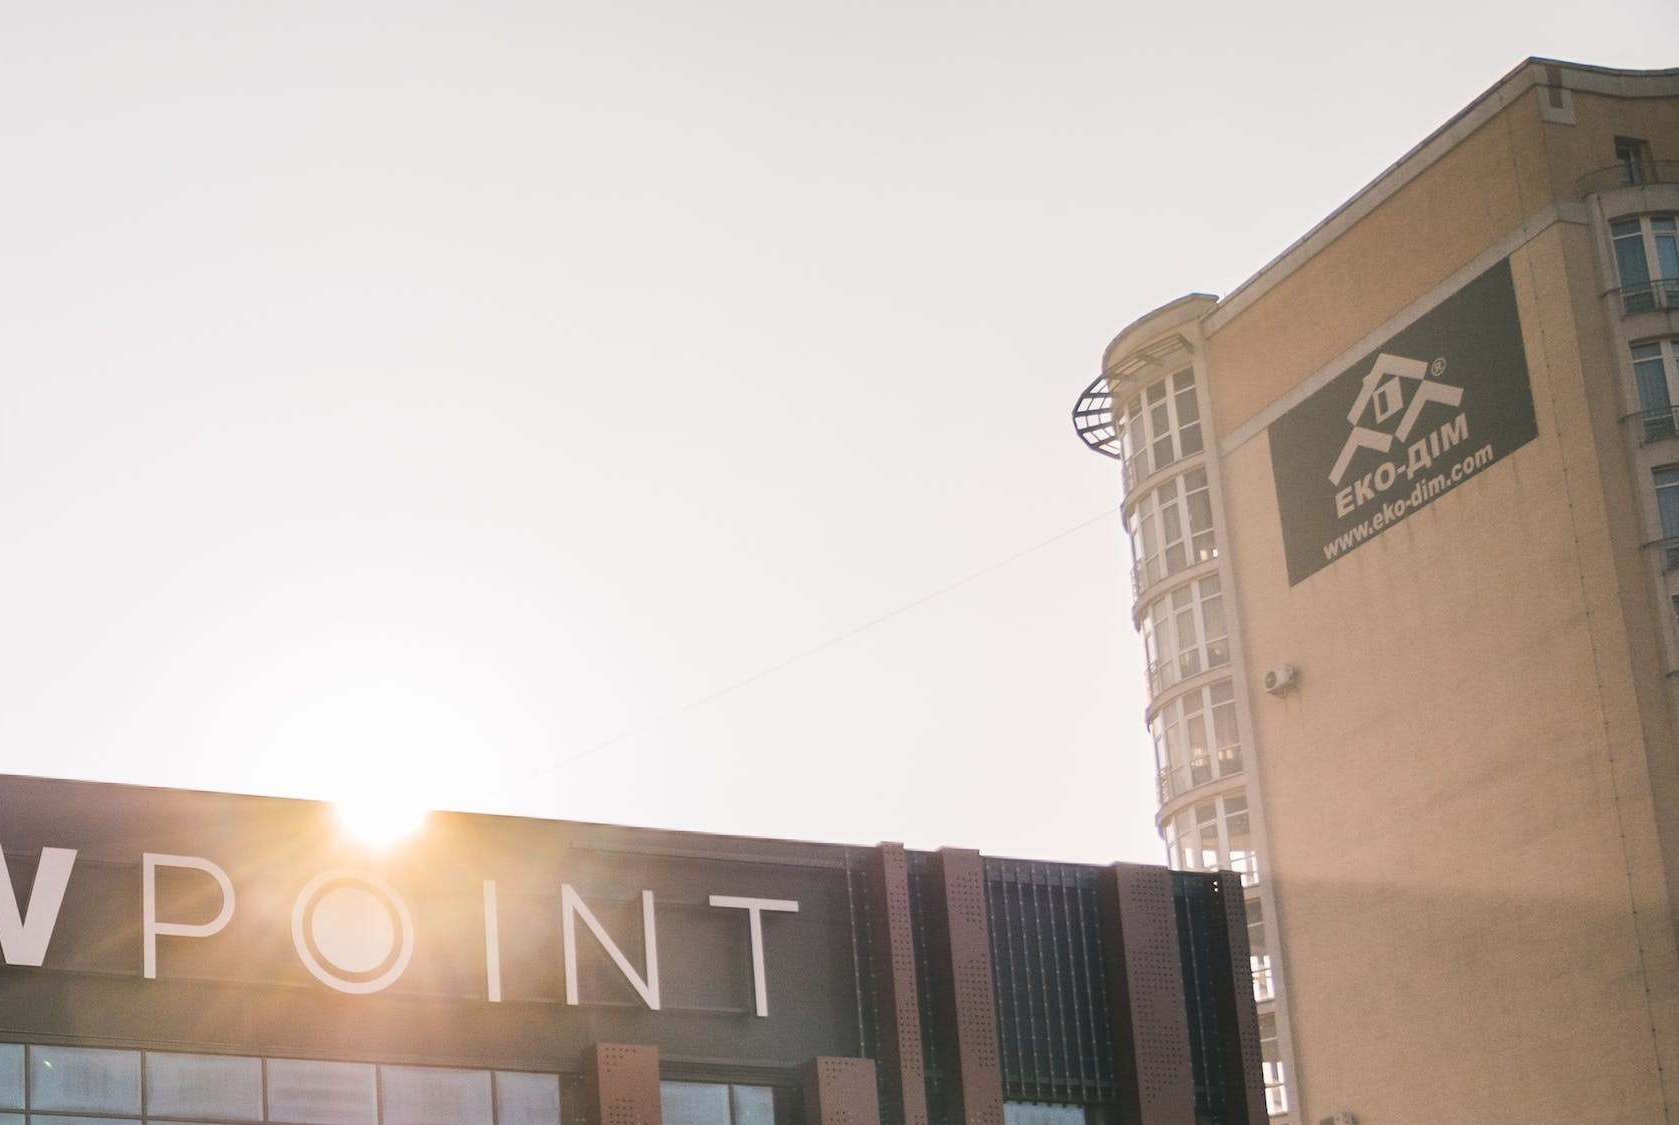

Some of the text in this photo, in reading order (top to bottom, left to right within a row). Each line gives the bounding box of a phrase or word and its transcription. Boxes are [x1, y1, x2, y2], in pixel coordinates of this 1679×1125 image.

[1322, 443, 1495, 561] www.eko-dim.com
[1334, 412, 1469, 519] ЕКО-ДІМ
[142, 852, 800, 1018] POINT
